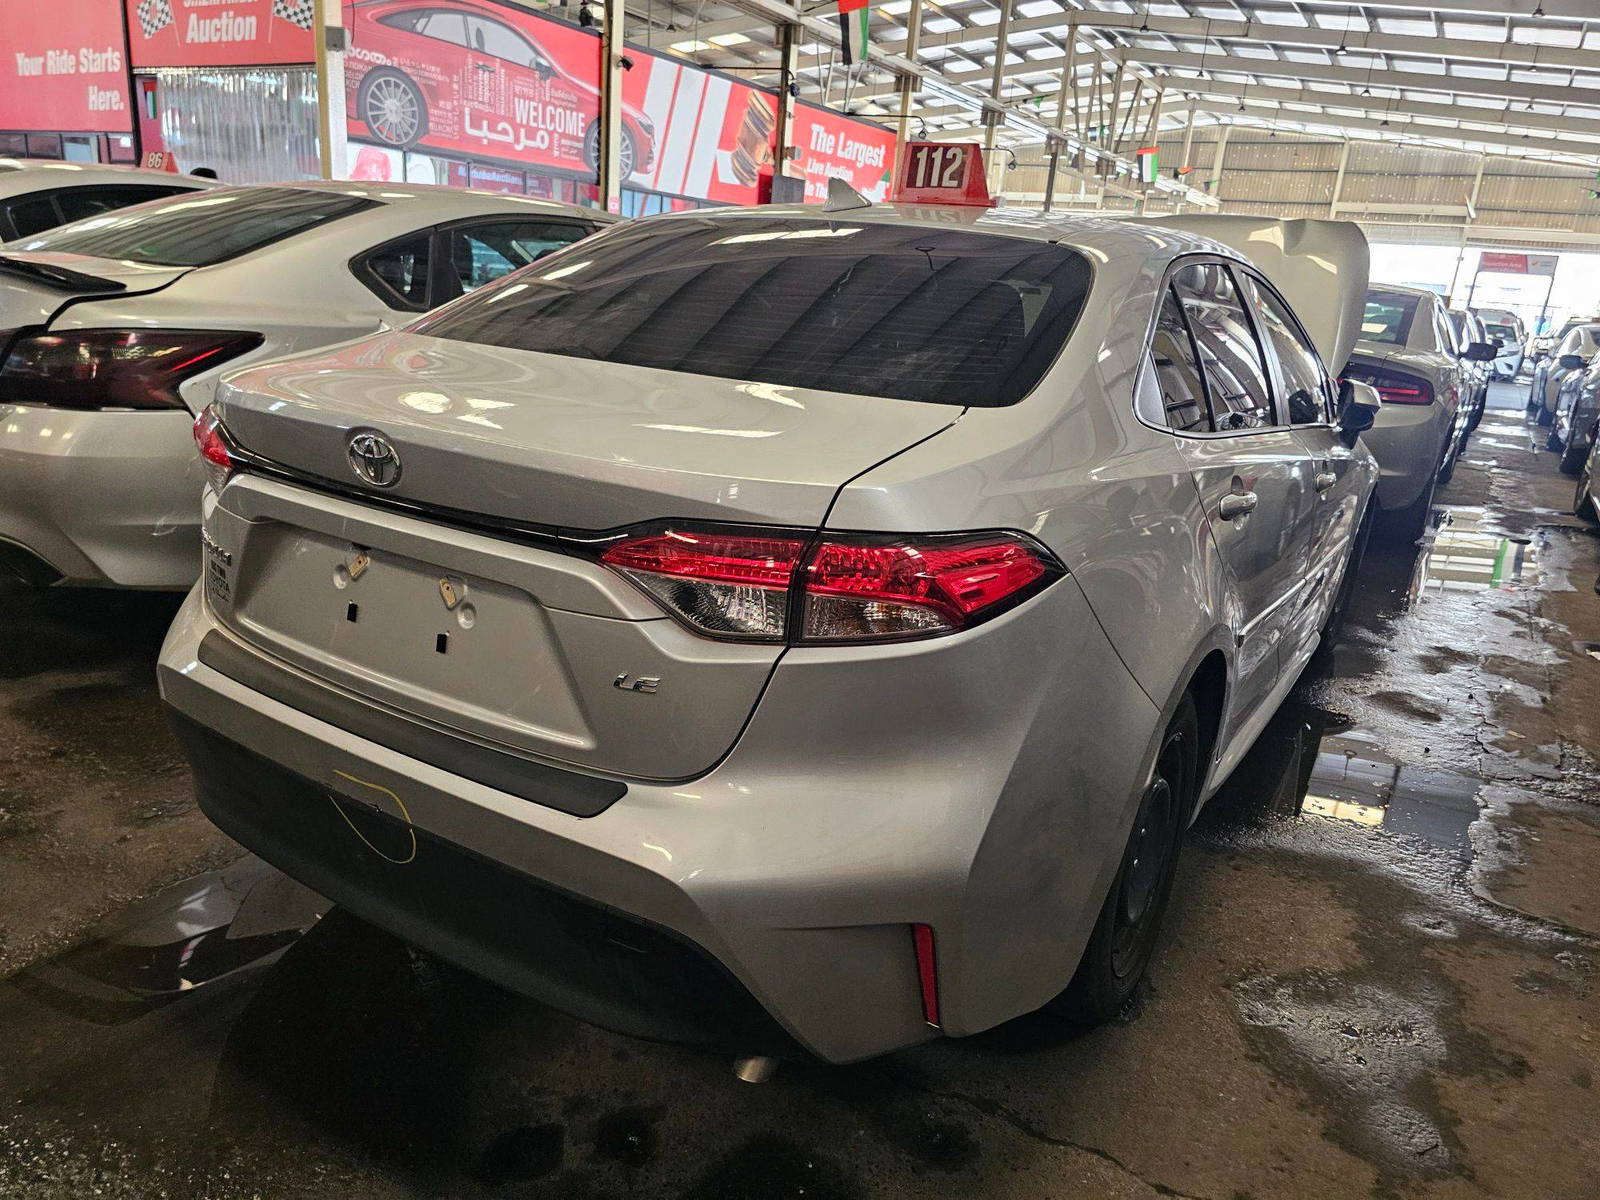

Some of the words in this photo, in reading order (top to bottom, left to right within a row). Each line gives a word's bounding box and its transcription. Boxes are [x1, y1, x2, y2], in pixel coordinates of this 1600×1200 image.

[186, 11, 257, 43] Auction
[16, 52, 44, 76] Your
[46, 49, 76, 75] Ride
[79, 47, 121, 73] Starts
[88, 85, 124, 111] Here.
[464, 106, 550, 151] مرحبا
[514, 97, 586, 138] WELCOME
[147, 152, 163, 168] 86
[810, 123, 835, 154] The
[837, 132, 886, 168] Largest
[806, 158, 824, 175] Live
[915, 146, 963, 188] 112
[613, 671, 661, 694] LE
